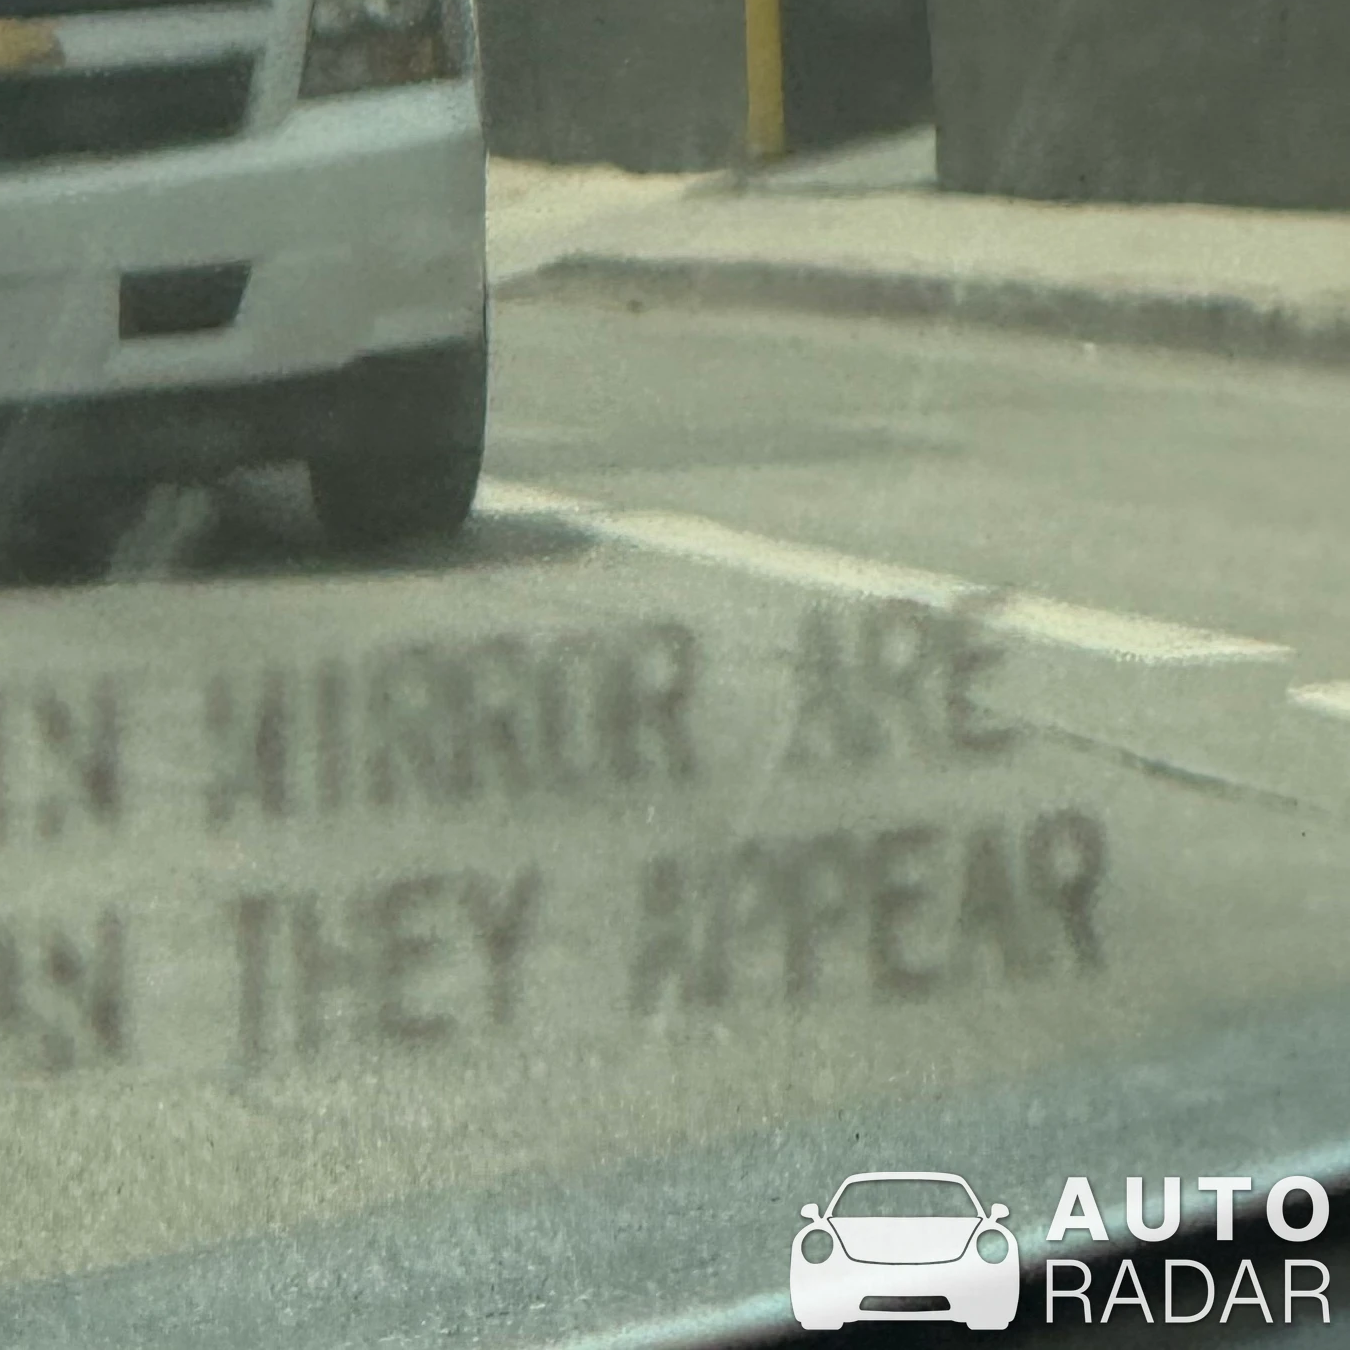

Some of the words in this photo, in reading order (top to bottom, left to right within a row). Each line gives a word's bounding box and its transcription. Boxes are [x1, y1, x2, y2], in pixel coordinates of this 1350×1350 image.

[203, 623, 700, 832] MIRROR
[782, 595, 1020, 768] ARE
[234, 865, 542, 1065] THEY
[632, 807, 1108, 1015] APPEAR
